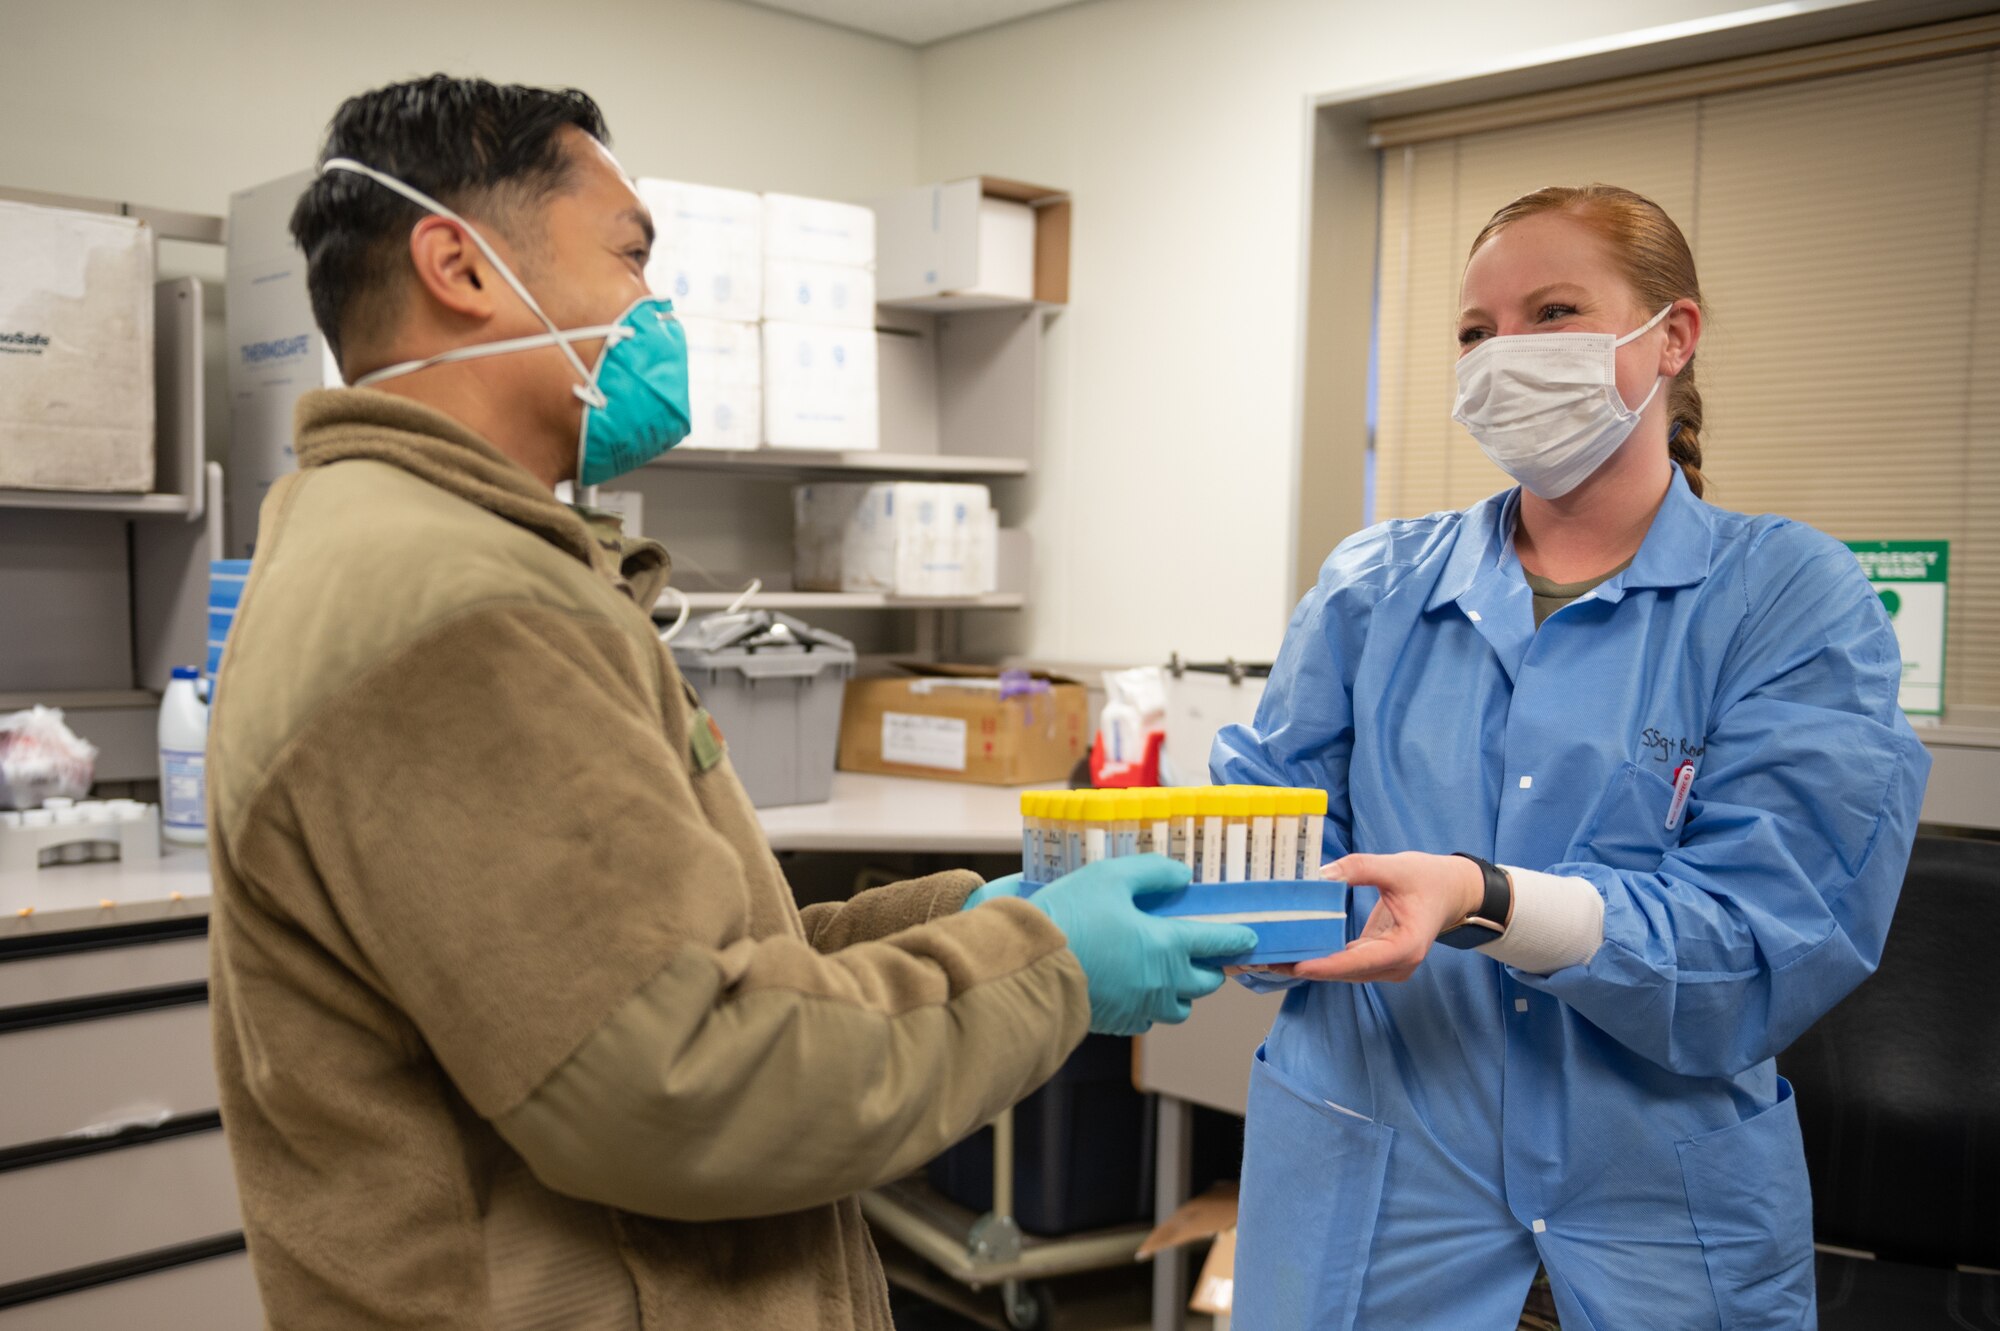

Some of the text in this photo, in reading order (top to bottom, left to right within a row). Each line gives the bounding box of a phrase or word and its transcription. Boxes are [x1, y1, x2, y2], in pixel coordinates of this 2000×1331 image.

[1854, 552, 1938, 566] ERGENCY
[1877, 566, 1927, 578] WASH
[1642, 728, 1676, 762] SSgt
